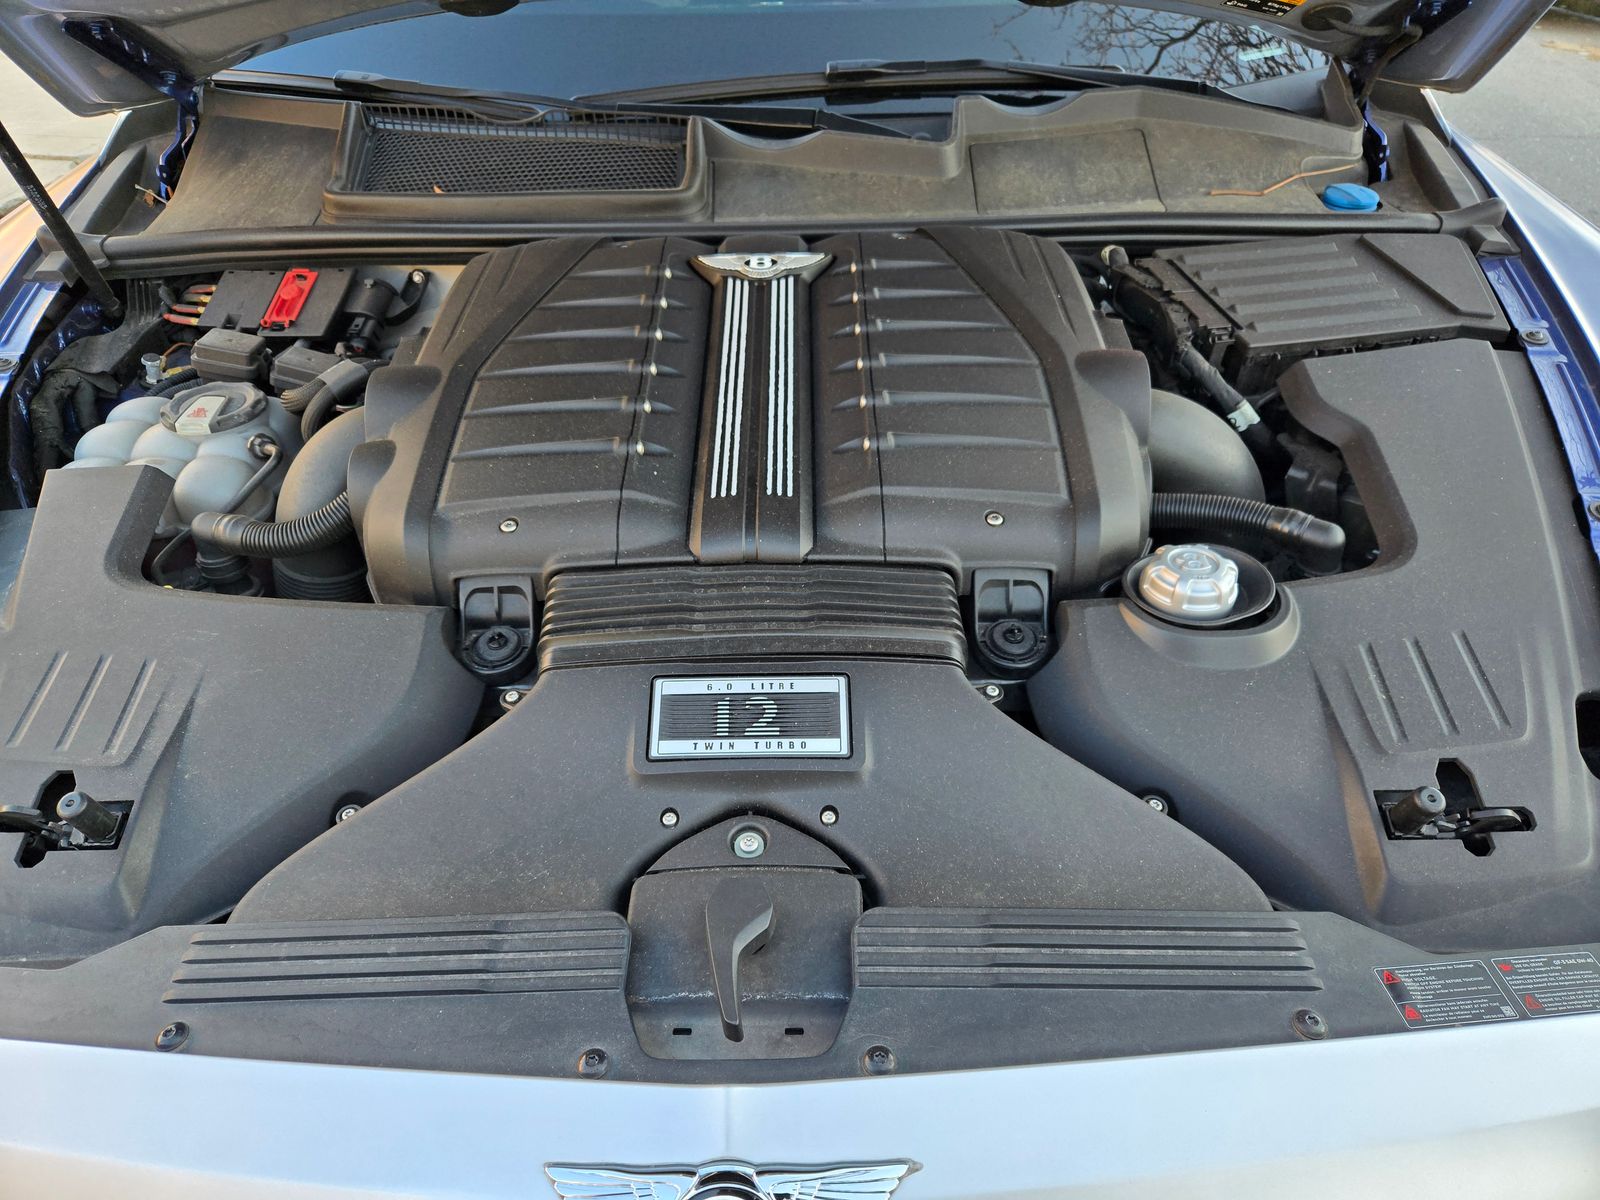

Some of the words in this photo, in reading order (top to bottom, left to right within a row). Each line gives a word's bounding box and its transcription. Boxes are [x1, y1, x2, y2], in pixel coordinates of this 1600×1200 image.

[706, 682, 733, 691] 6.0
[751, 682, 796, 690] LITRE
[715, 696, 780, 736] 12
[692, 741, 736, 751] TWIN
[753, 740, 808, 750] TURBO
